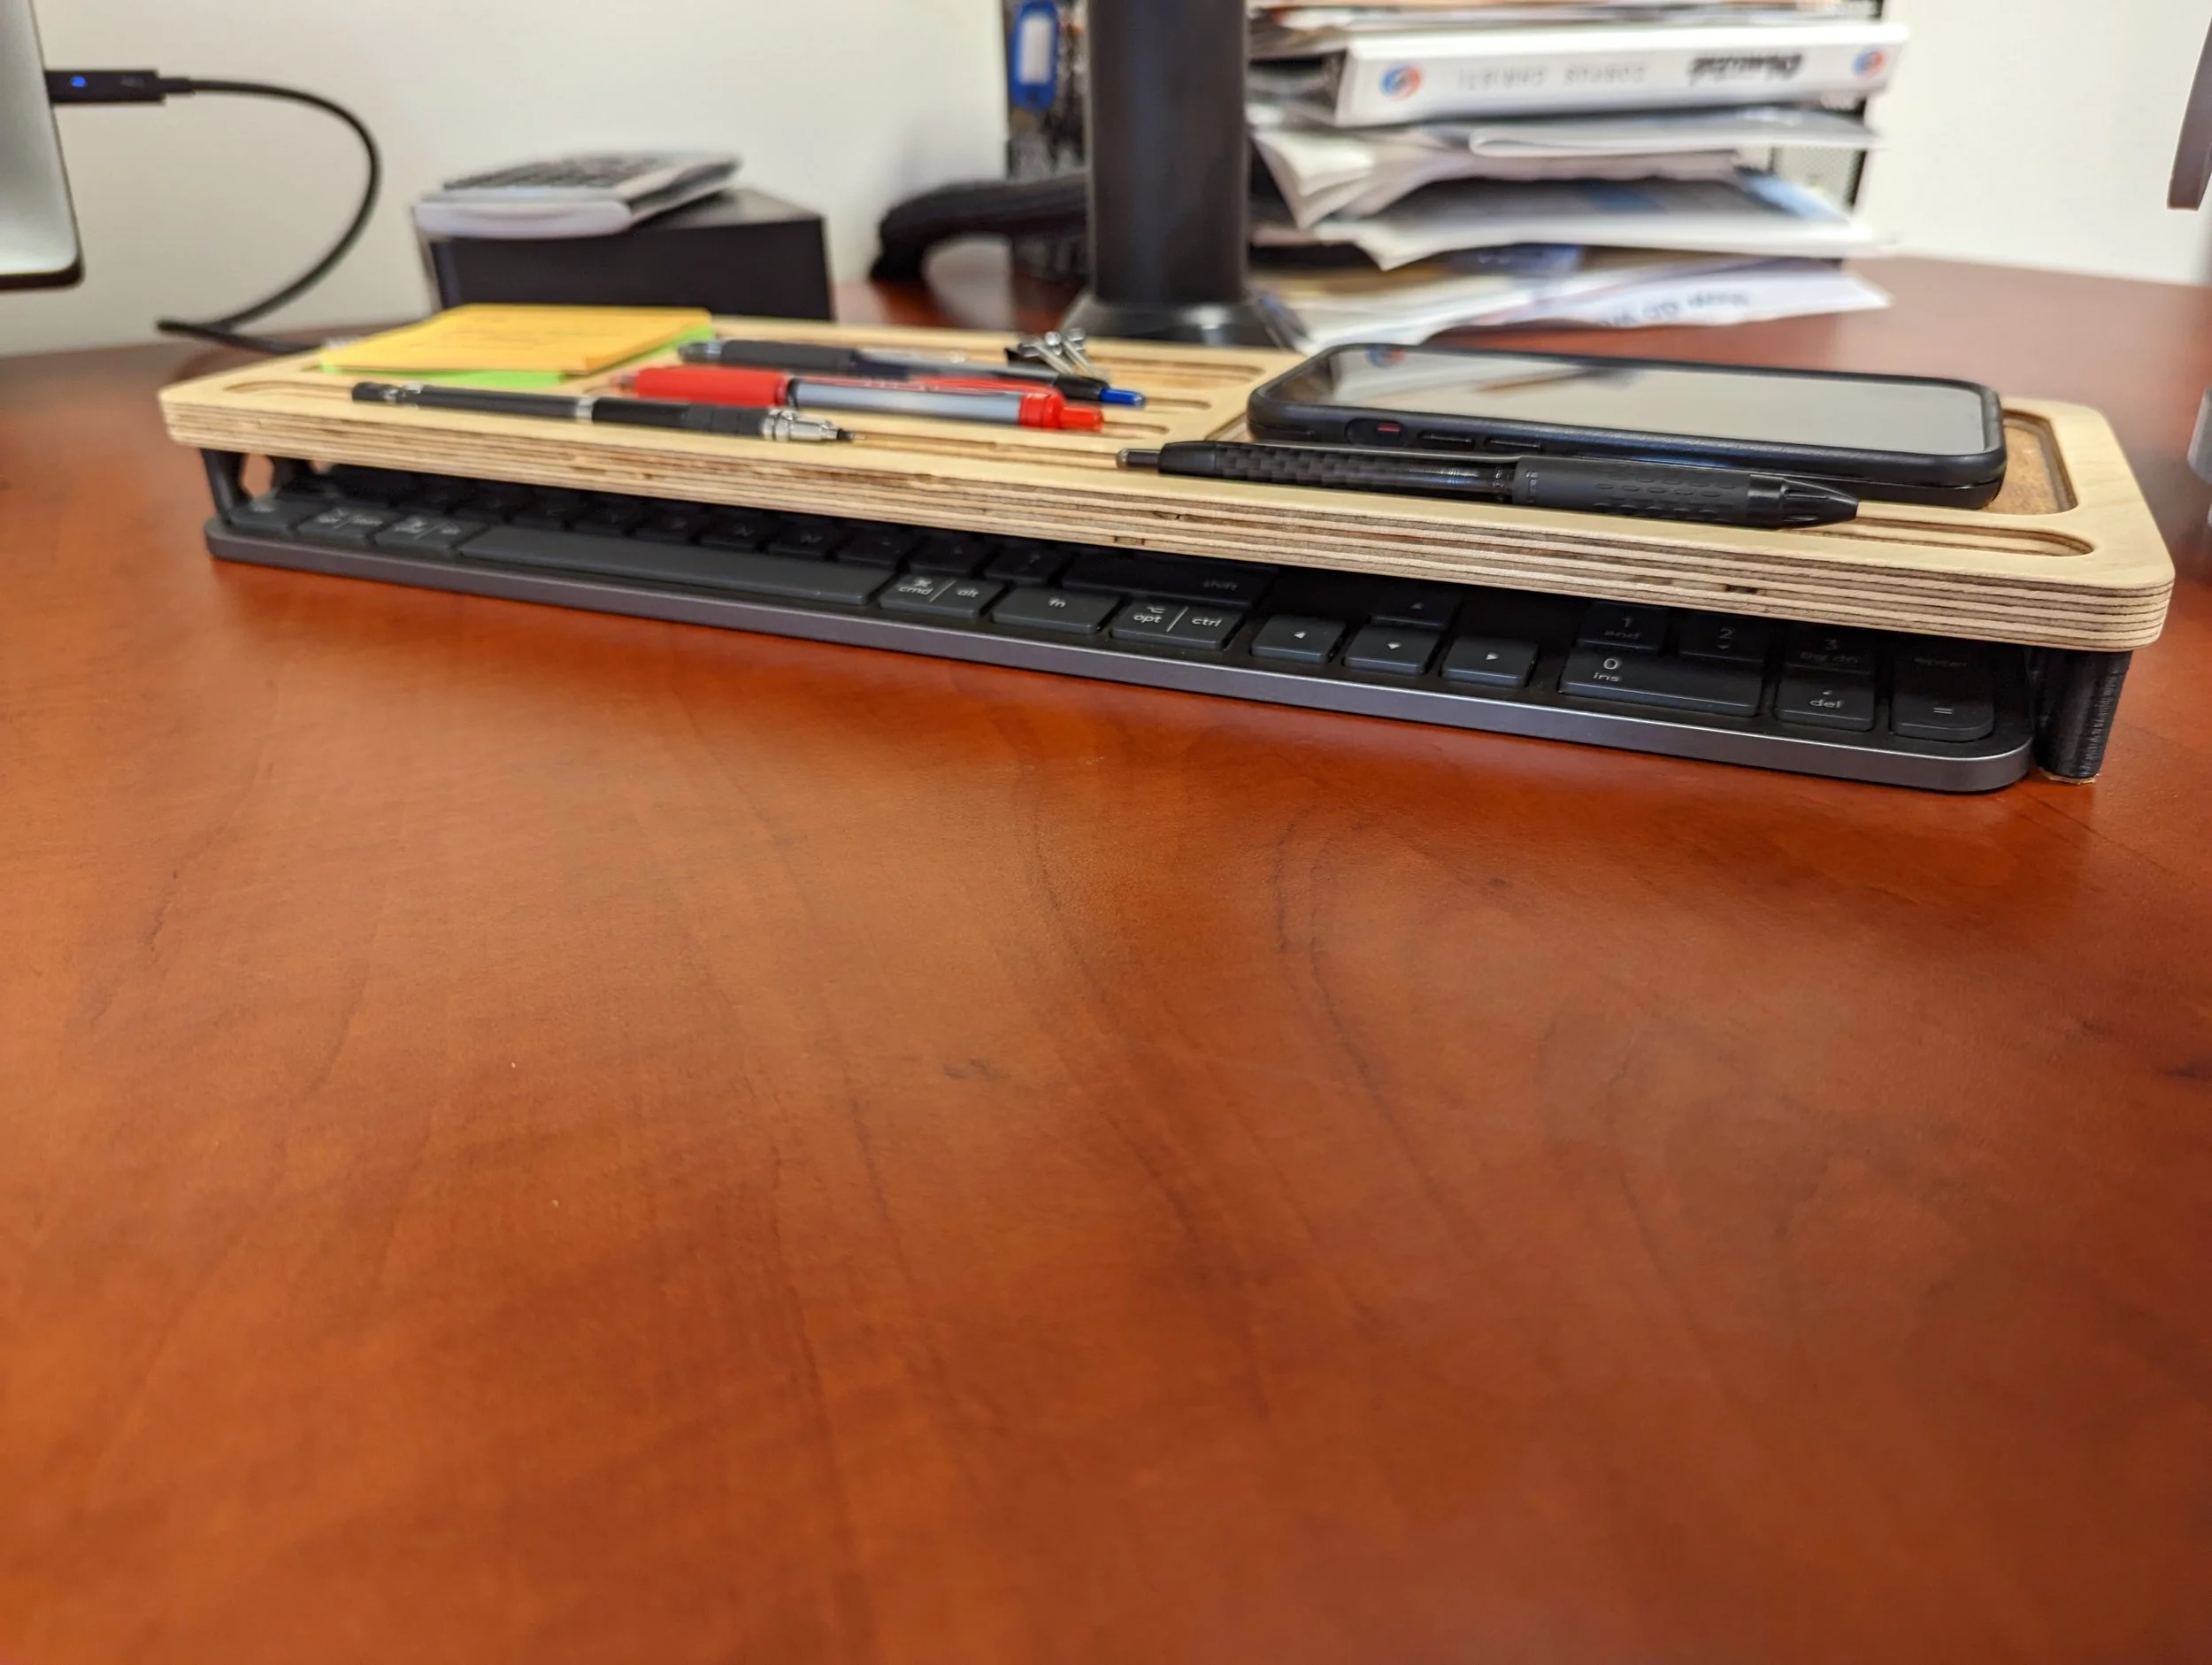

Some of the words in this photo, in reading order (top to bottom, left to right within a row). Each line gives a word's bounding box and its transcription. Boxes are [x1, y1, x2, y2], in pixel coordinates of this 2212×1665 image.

[898, 585, 933, 595] cmd
[1202, 579, 1238, 591] shift
[956, 587, 979, 598] alt
[1048, 597, 1066, 608] fn
[1133, 613, 1162, 624] opt
[1192, 618, 1223, 627] ctrl
[1622, 616, 1634, 628] 1
[1604, 630, 1641, 640] end
[1717, 627, 1736, 640] 2
[1824, 636, 1839, 651] 3
[1603, 657, 1620, 670] 0
[1593, 671, 1622, 682] ins
[1809, 698, 1845, 709] del
